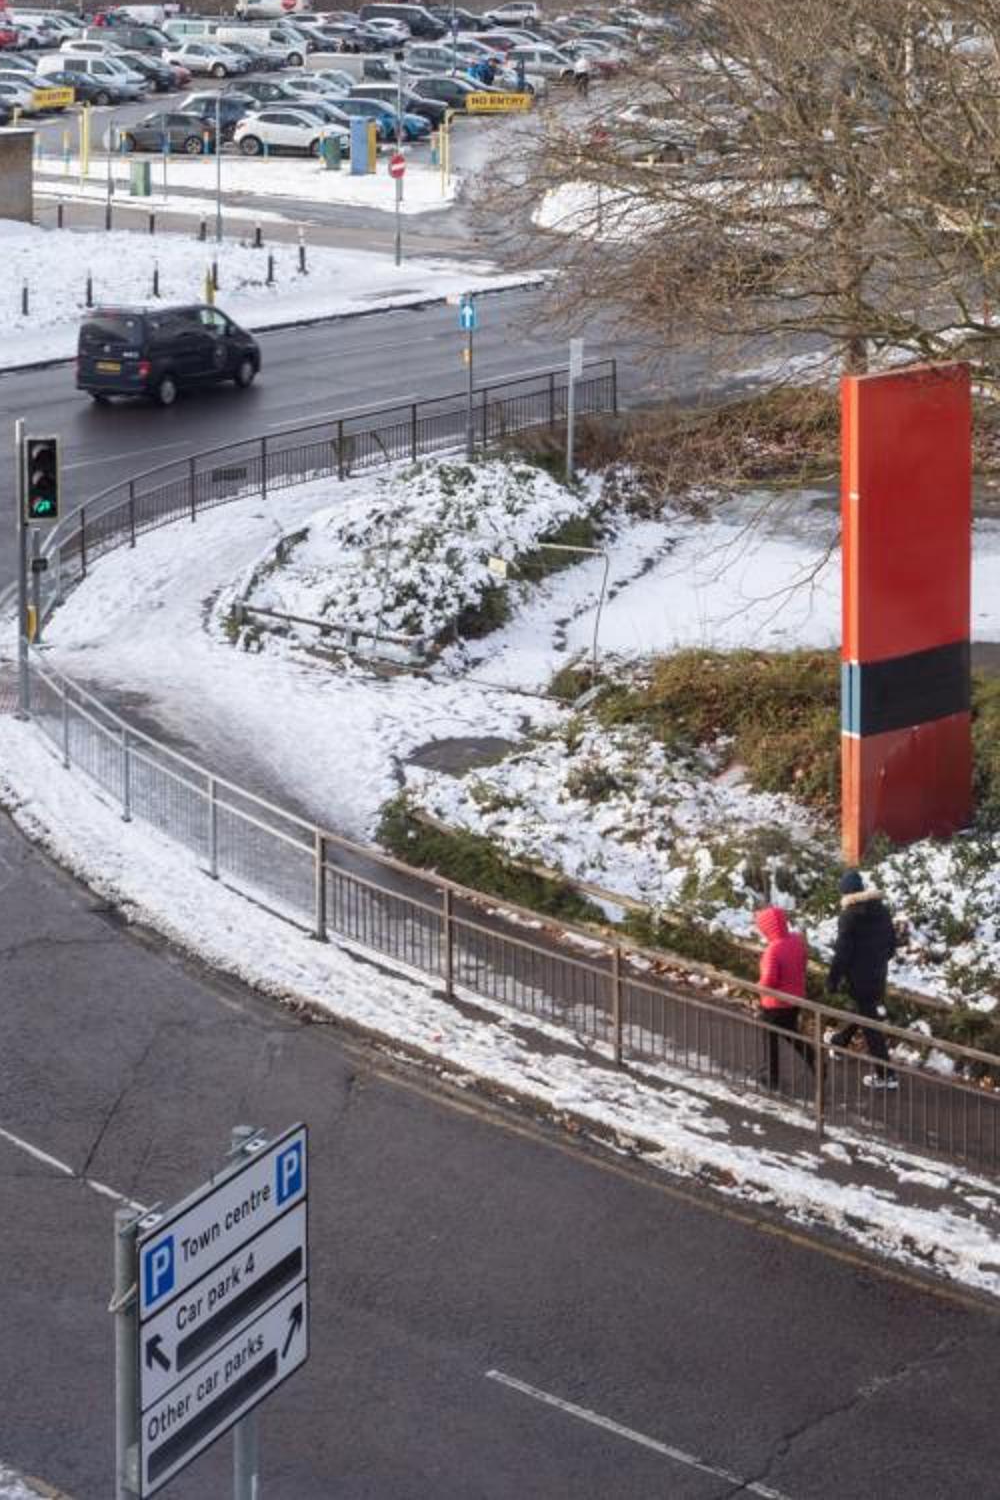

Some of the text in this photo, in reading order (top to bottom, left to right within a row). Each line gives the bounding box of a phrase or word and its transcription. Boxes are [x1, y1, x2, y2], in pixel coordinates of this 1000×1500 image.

[181, 1183, 271, 1263] Town centre
[176, 1251, 255, 1330] Car park 4
[147, 1332, 265, 1442] Other car parks
